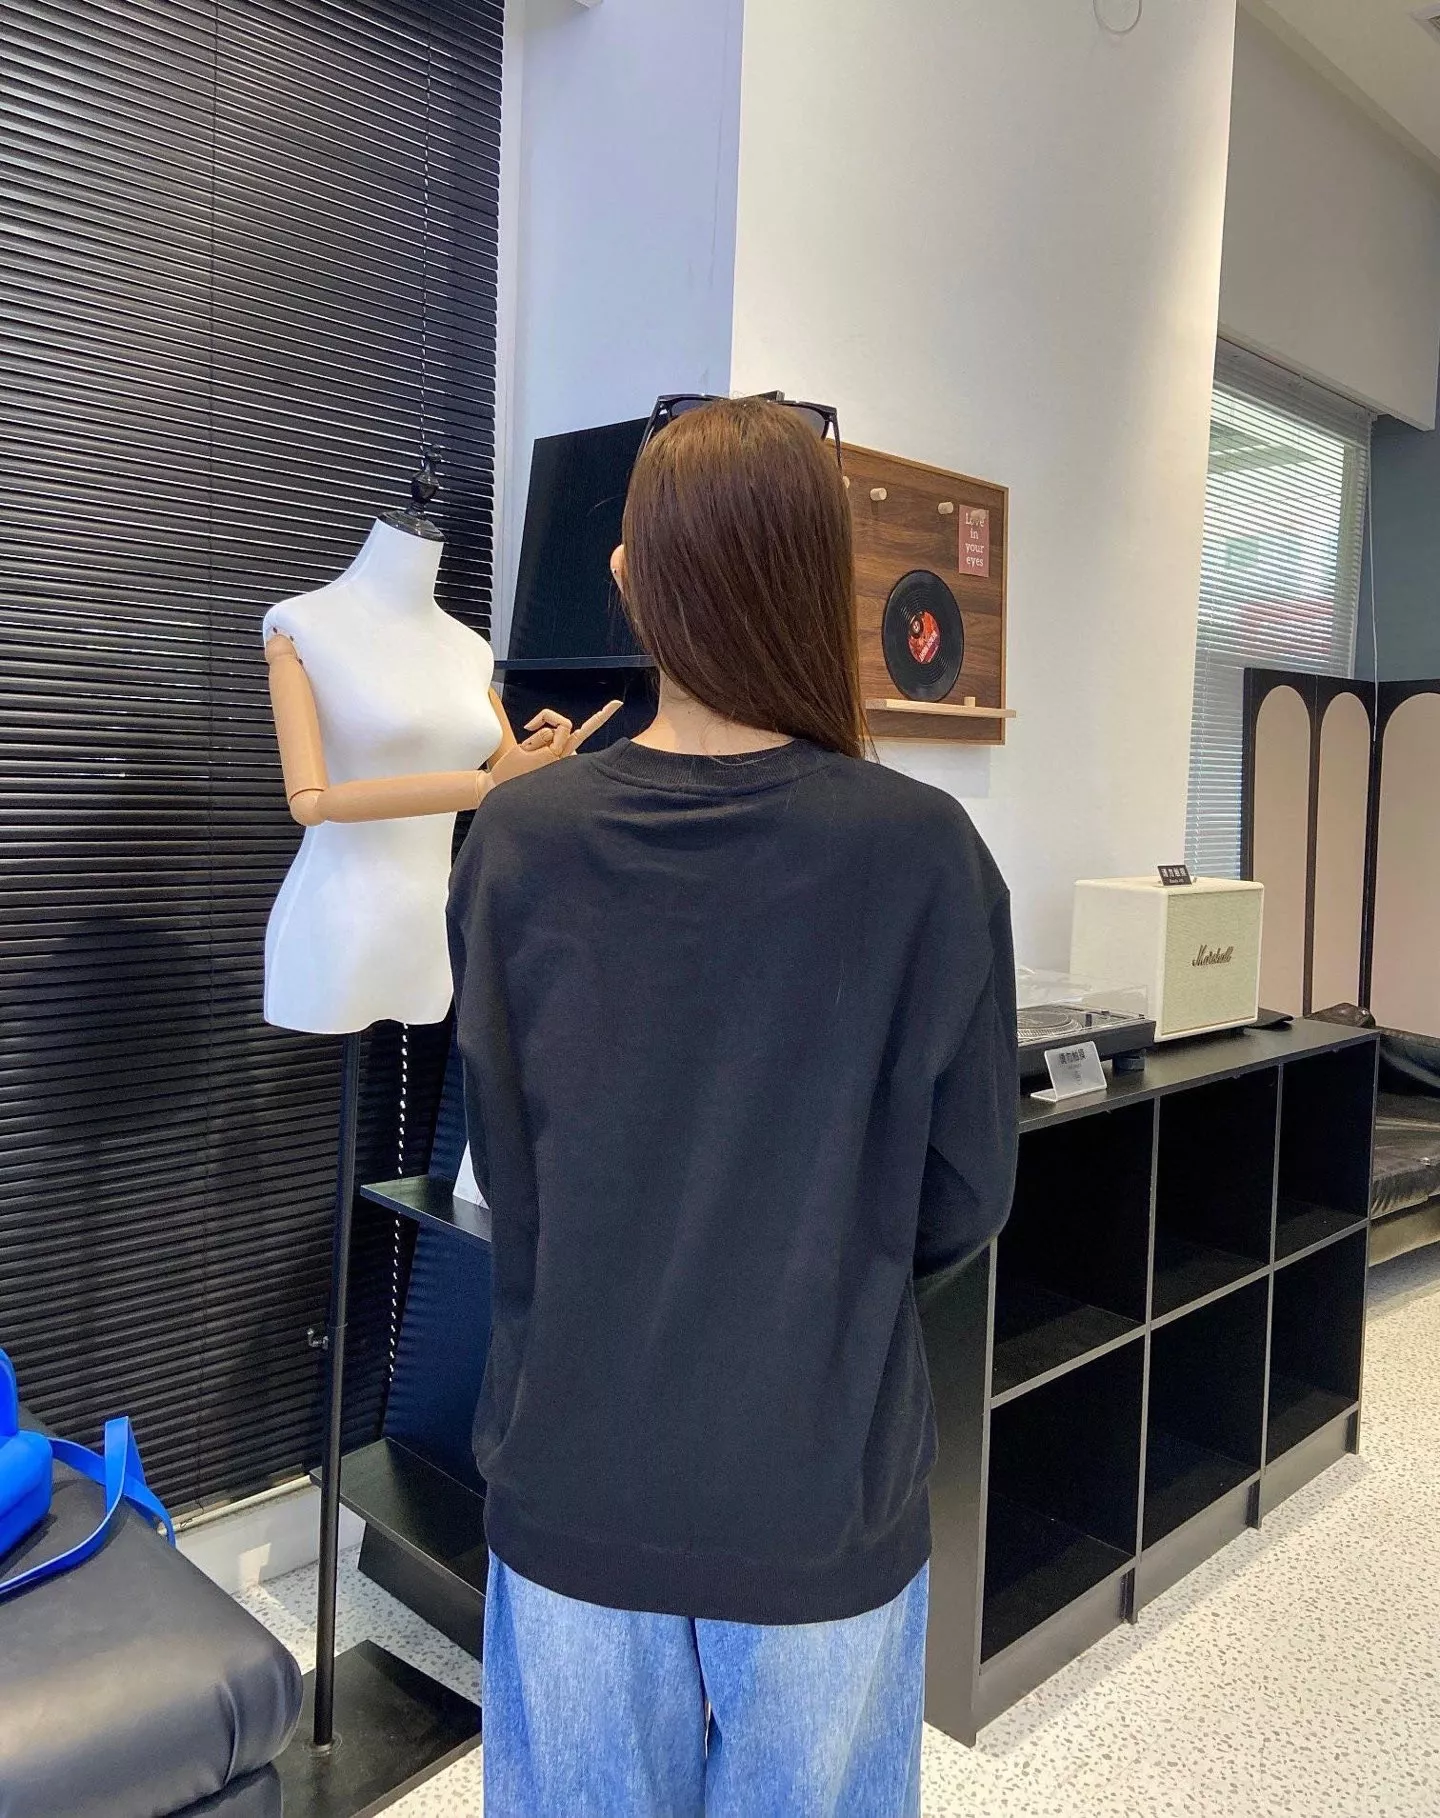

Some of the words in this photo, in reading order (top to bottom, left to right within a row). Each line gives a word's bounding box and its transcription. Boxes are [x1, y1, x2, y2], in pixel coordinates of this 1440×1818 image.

[970, 527, 979, 540] in
[965, 542, 985, 554] your
[966, 556, 984, 568] eyes
